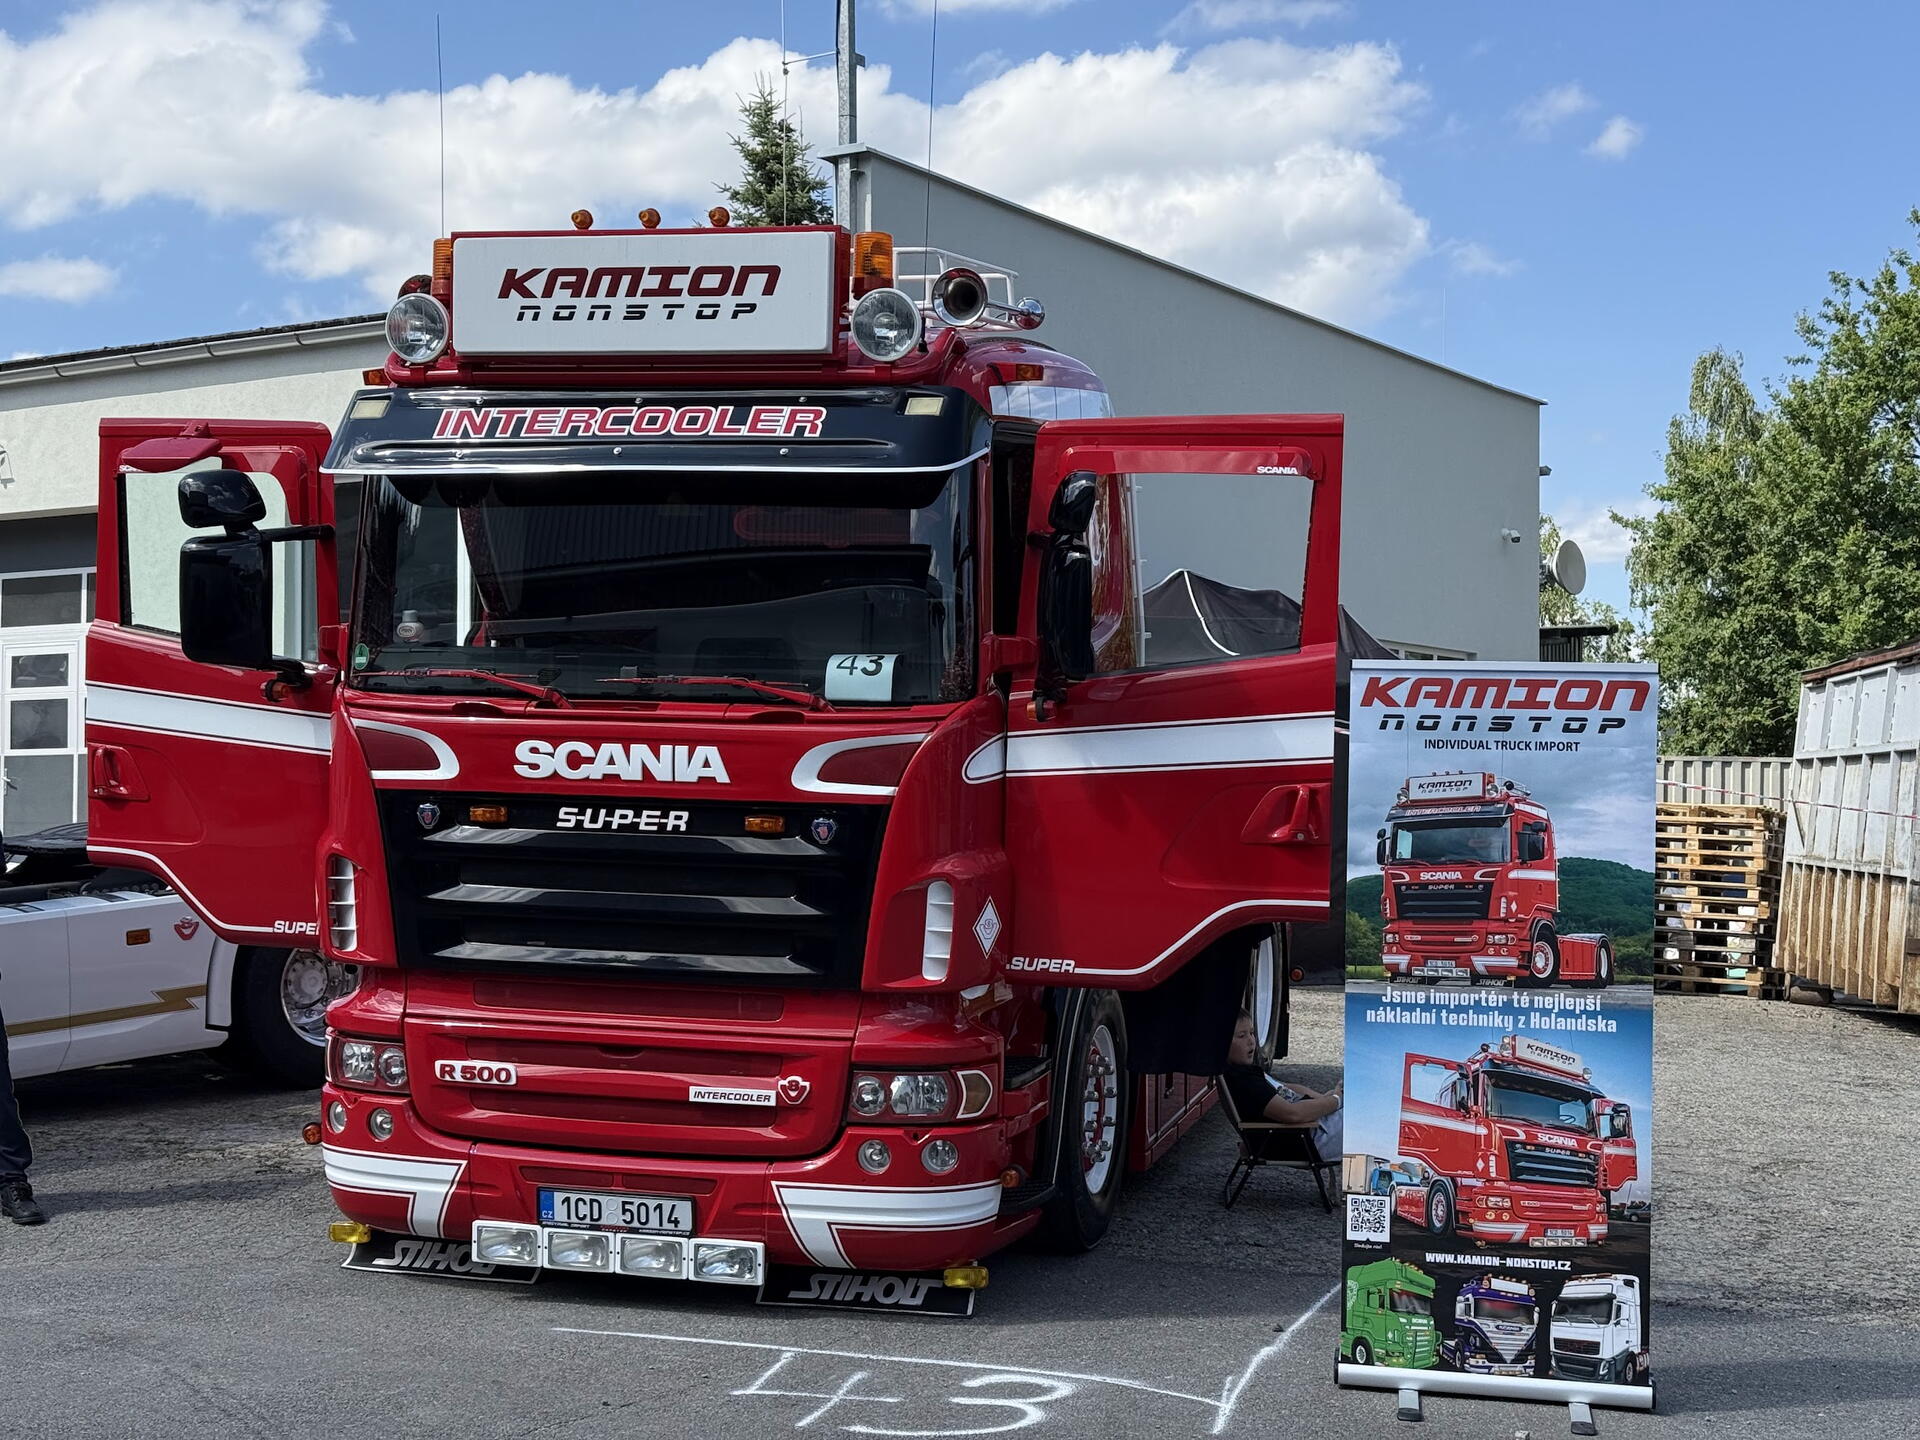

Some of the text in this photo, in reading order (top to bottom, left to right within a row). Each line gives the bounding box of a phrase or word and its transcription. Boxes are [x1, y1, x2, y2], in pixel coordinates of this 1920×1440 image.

[498, 265, 781, 300] KAMION
[516, 303, 758, 322] NONSTOP
[432, 406, 827, 439] INTERCOOLER
[1256, 465, 1298, 475] SCANIA
[836, 654, 883, 677] 43
[1360, 676, 1651, 712] KAMION
[1378, 714, 1626, 734] NONSTOP
[1424, 739, 1580, 752] INDIVIDUAL TRUCK IMPORT
[513, 738, 731, 784] SCANIA
[1418, 779, 1472, 790] KAMION
[1420, 871, 1462, 880] SCANIA
[274, 920, 320, 936] SUPE
[1010, 957, 1076, 973] SUPER
[1382, 986, 1601, 1014] Jsme importér té nejlepší
[1366, 1007, 1617, 1033] nákladní techniky z Holandska
[1526, 1043, 1576, 1063] KAMION
[439, 1063, 512, 1083] R 500
[693, 1090, 771, 1104] INTERCOOLER
[1538, 1133, 1578, 1147] SCANIA
[542, 1210, 554, 1219] CZ
[561, 1196, 681, 1228] 1CD 5014
[1425, 1252, 1572, 1271] WWW.KAMION-NONSTOP.CZ
[787, 1273, 947, 1306] STIHOLT
[730, 1350, 1083, 1437] 43
